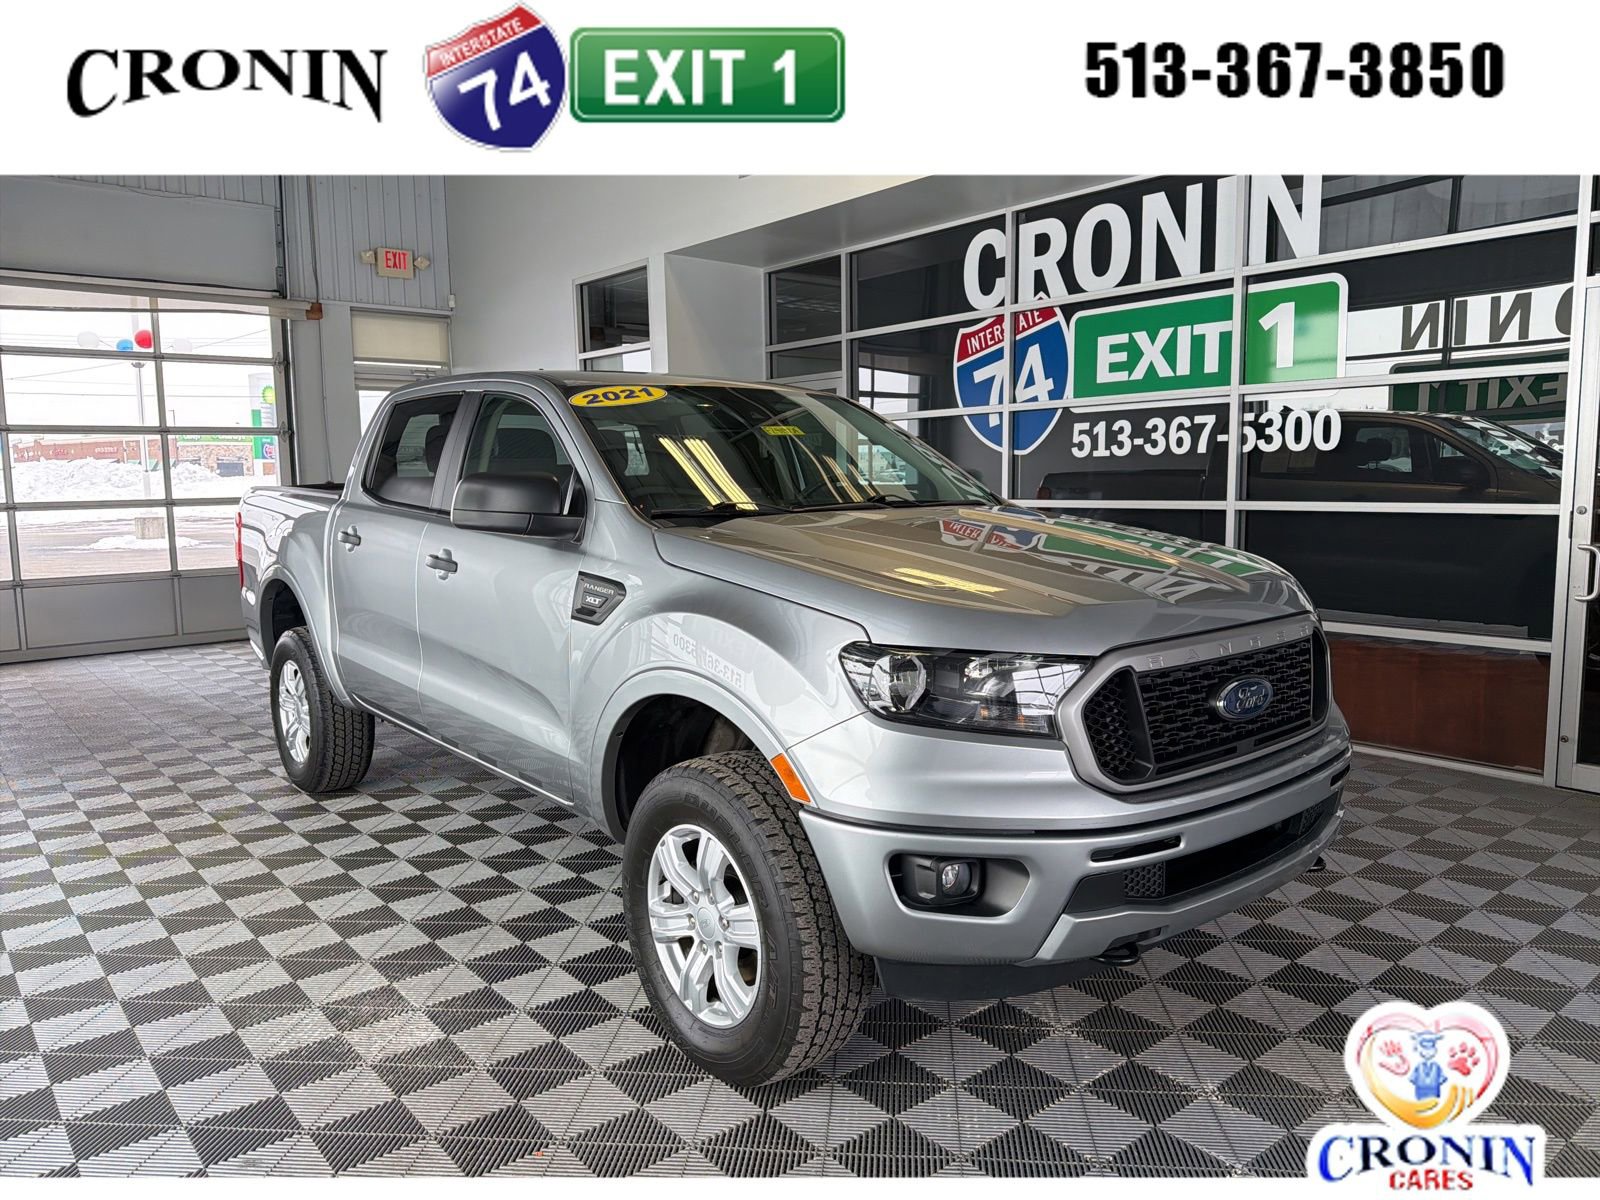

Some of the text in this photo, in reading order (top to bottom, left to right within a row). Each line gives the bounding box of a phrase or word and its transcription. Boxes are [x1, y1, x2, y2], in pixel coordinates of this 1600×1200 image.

[963, 174, 1322, 310] CRONIN
[384, 250, 408, 270] EXIT
[967, 310, 1043, 354] INTERATE
[1096, 302, 1295, 383] EXIT 1
[582, 387, 654, 405] 2021
[973, 344, 1054, 428] 74
[1071, 409, 1342, 458] 513-367-5300
[583, 582, 615, 595] RANGER
[585, 595, 602, 605] XLT
[1236, 685, 1266, 712] Ford
